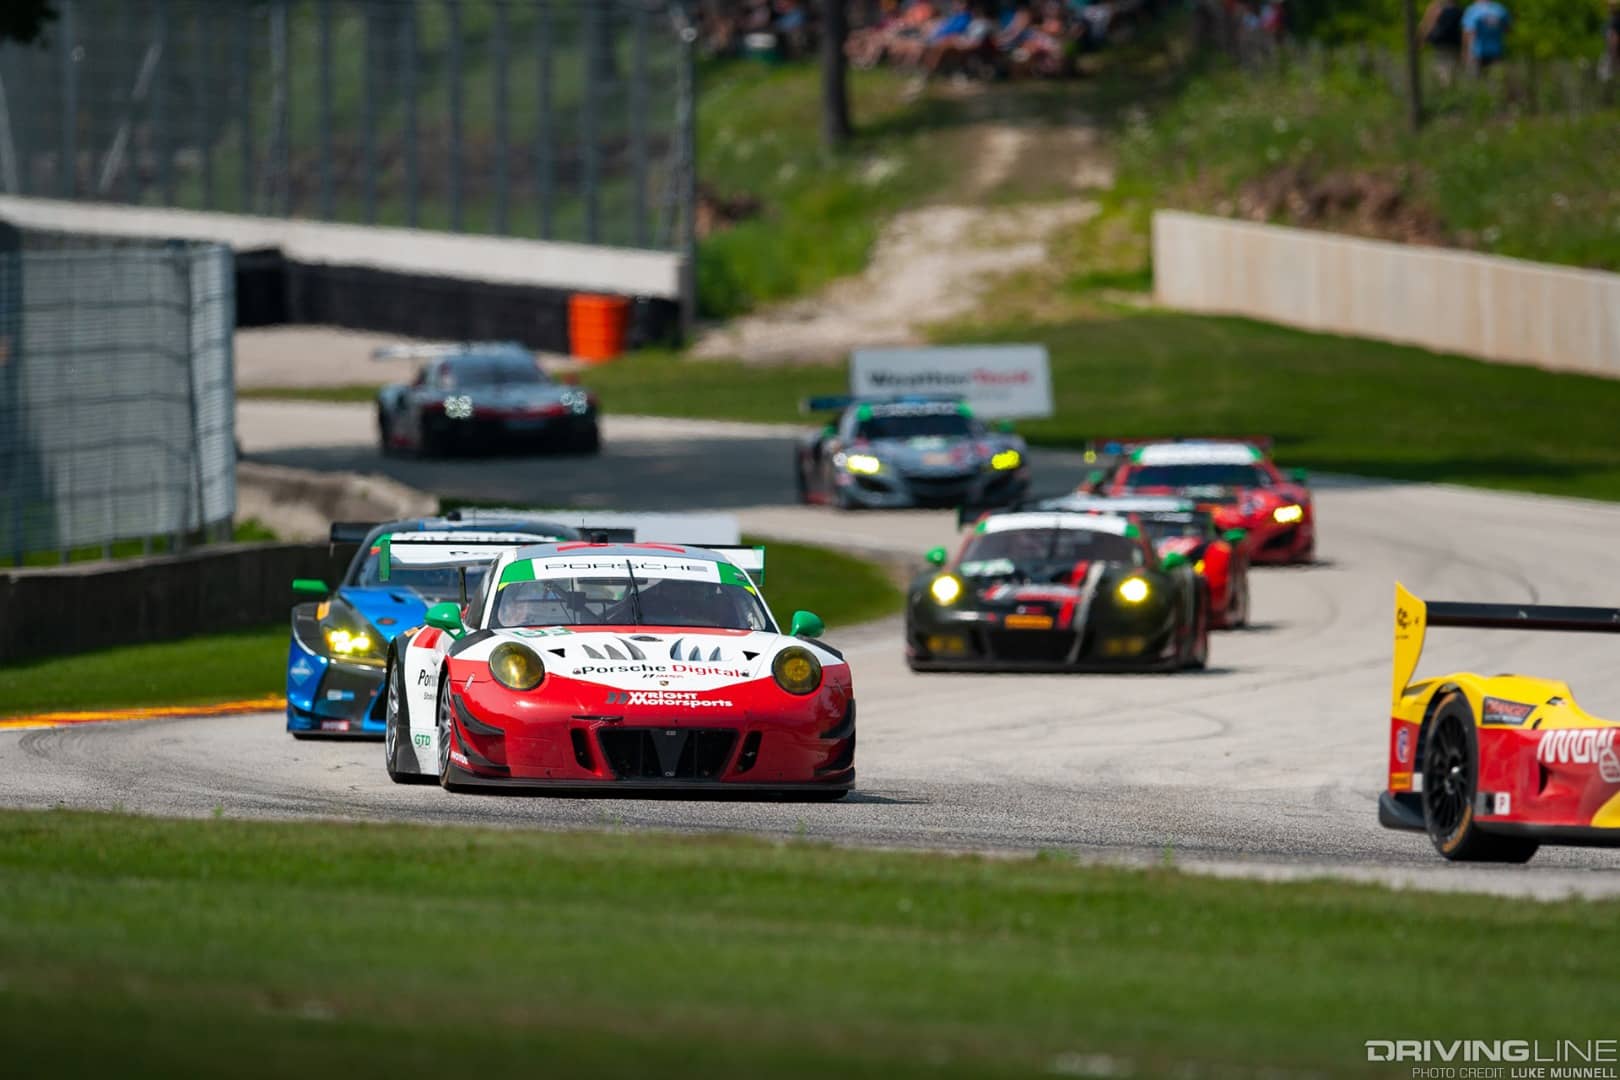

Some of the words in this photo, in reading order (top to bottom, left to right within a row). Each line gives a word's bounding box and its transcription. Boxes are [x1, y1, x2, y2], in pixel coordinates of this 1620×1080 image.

[582, 664, 666, 675] Porsche
[672, 664, 740, 678] Digital
[628, 698, 733, 708] Motorsports
[414, 734, 431, 746] GTD
